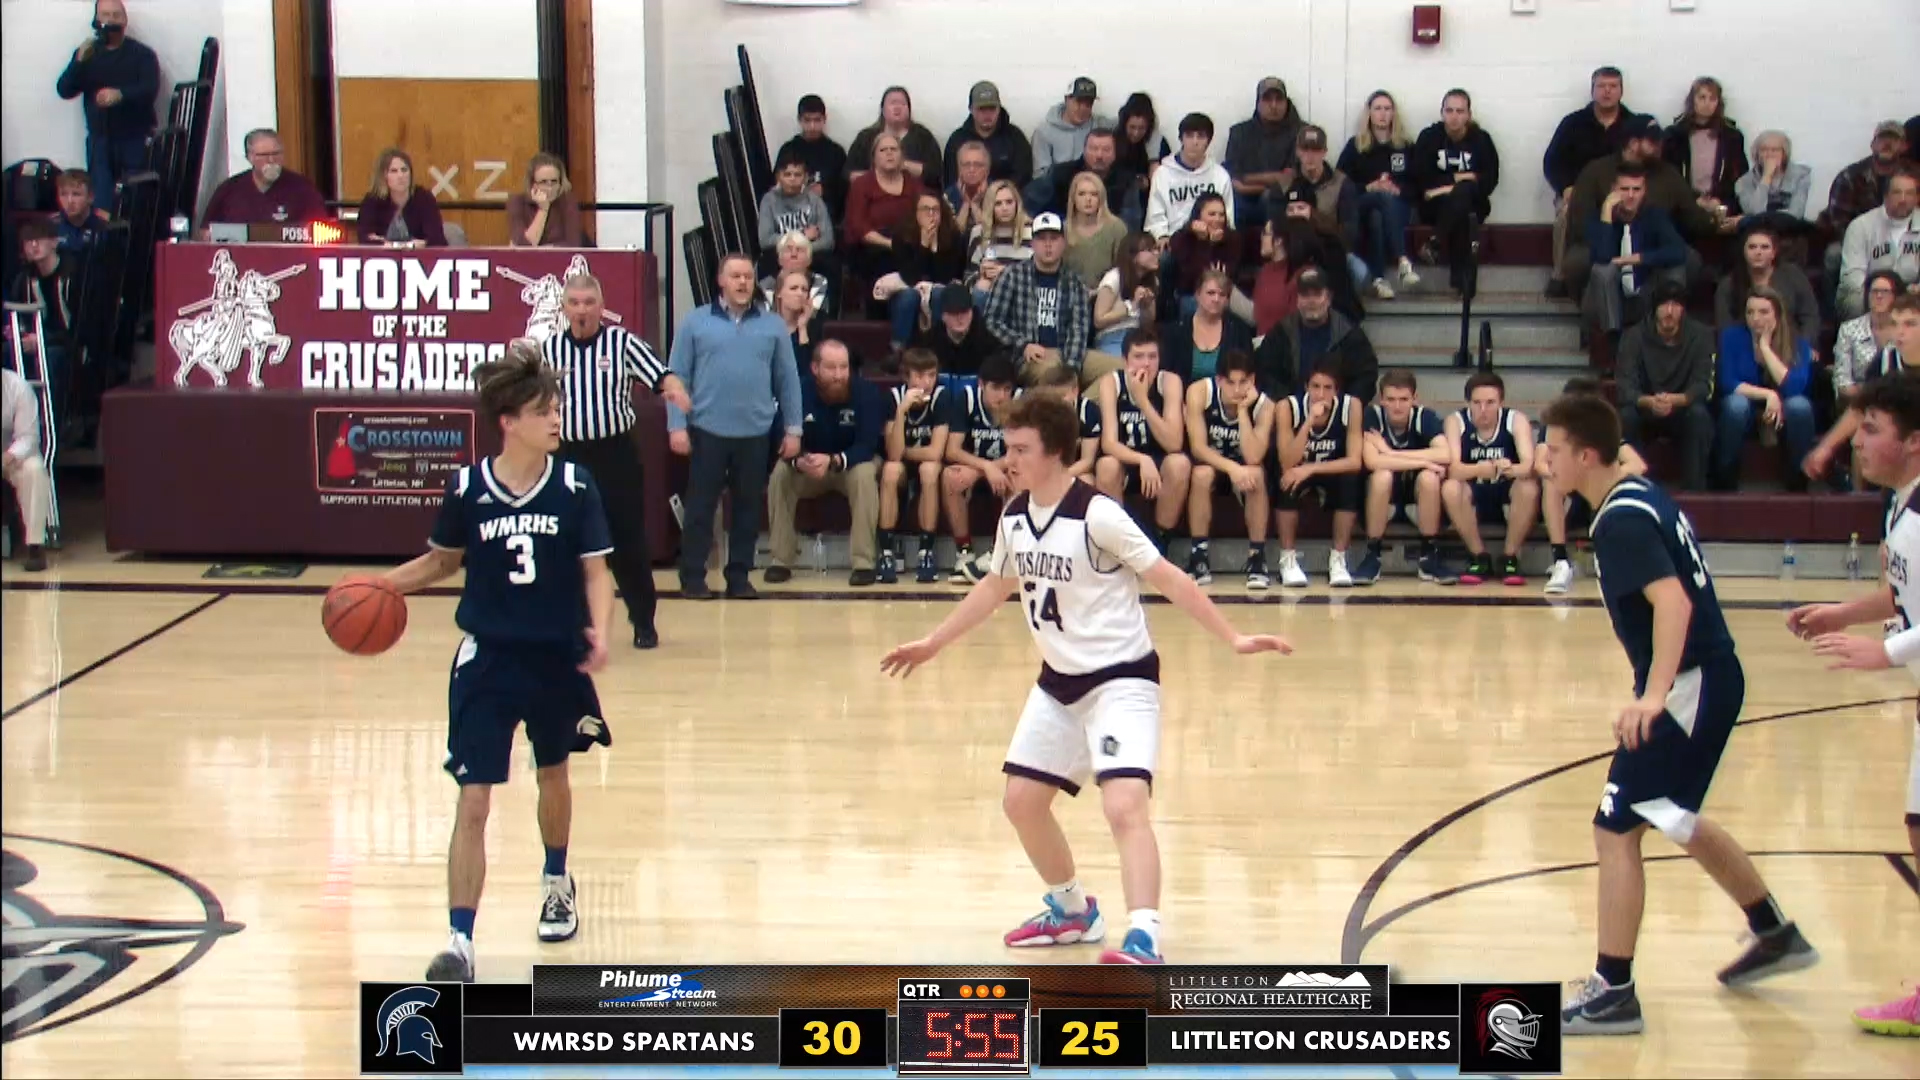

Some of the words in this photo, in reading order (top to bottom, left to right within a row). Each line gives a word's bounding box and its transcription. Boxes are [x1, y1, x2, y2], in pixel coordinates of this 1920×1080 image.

[474, 161, 509, 199] Z
[318, 257, 489, 311] HOME
[372, 315, 399, 338] OF
[402, 315, 447, 338] THE
[347, 425, 463, 451] CROSSTOWN
[320, 494, 369, 505] SUPPORTS
[372, 495, 421, 506] LITTLETON
[479, 513, 559, 542] WMRHS
[505, 534, 536, 585] 3
